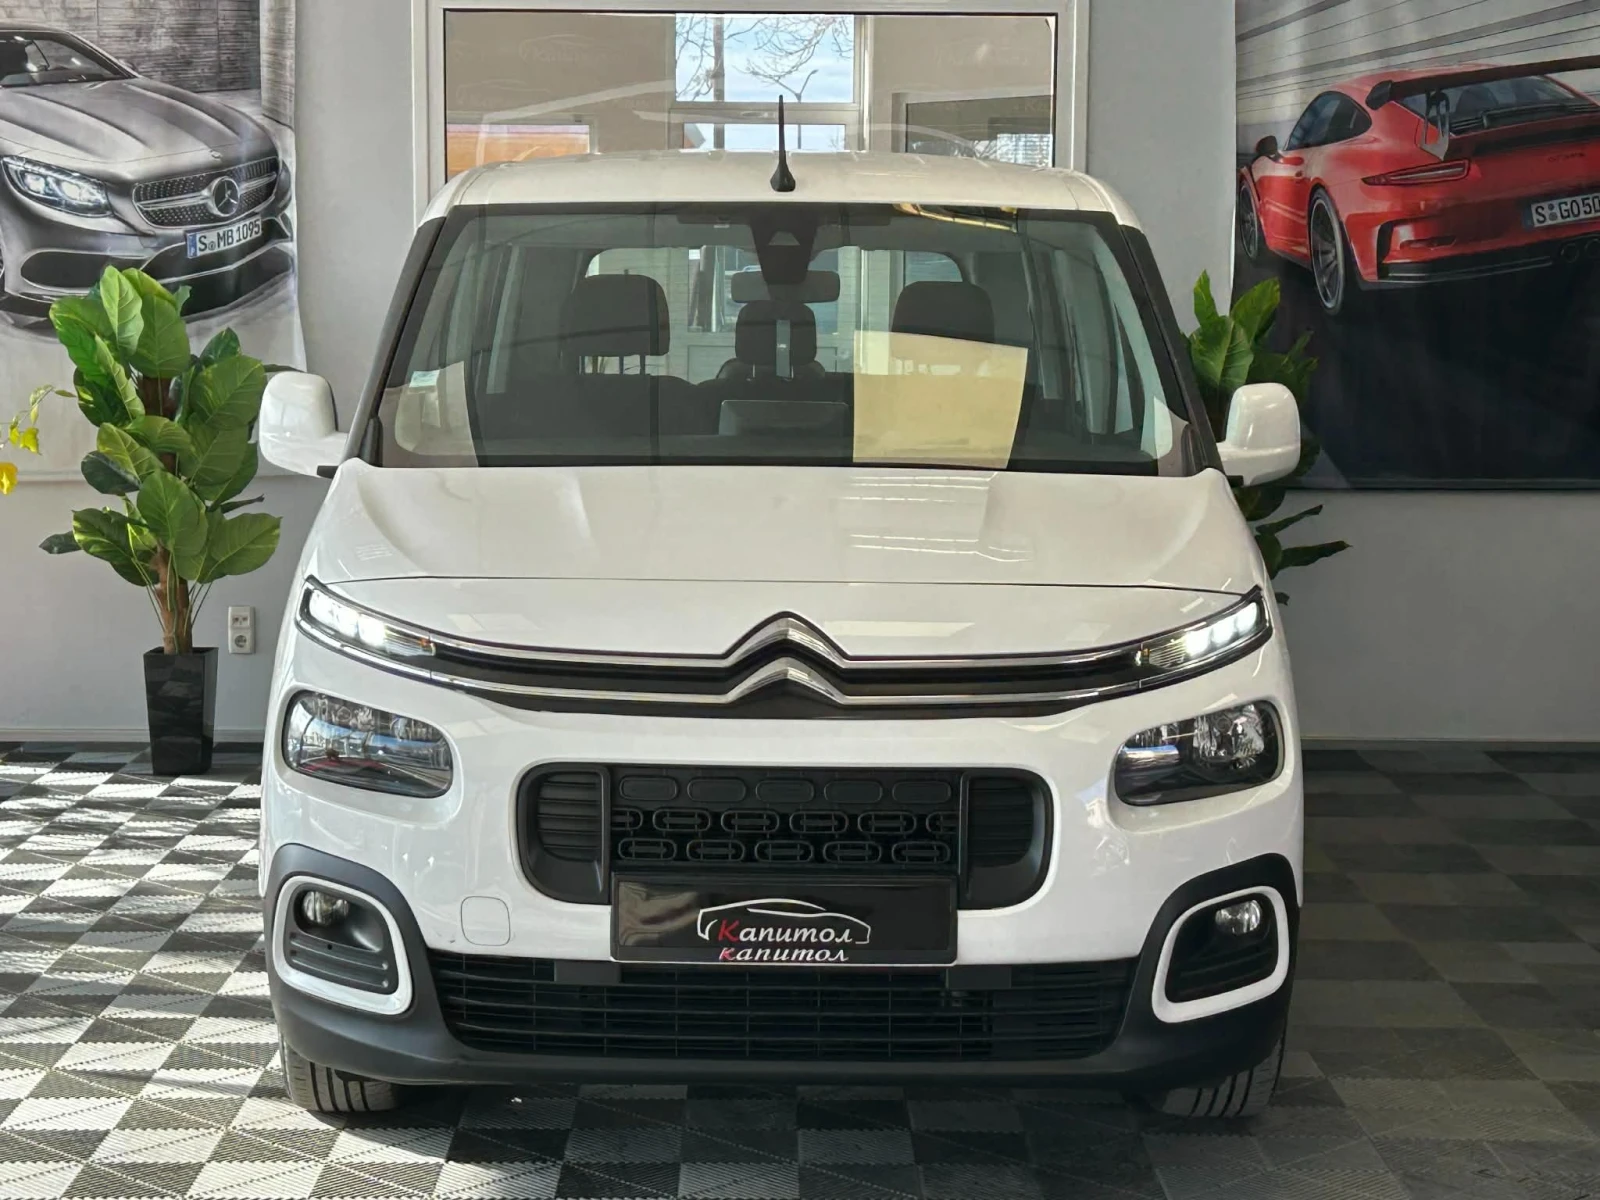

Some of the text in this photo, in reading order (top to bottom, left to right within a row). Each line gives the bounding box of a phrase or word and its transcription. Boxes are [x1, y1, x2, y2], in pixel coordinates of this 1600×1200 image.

[1534, 205, 1547, 224] S
[198, 219, 261, 252] S MB 1095
[718, 919, 853, 942] Капитол
